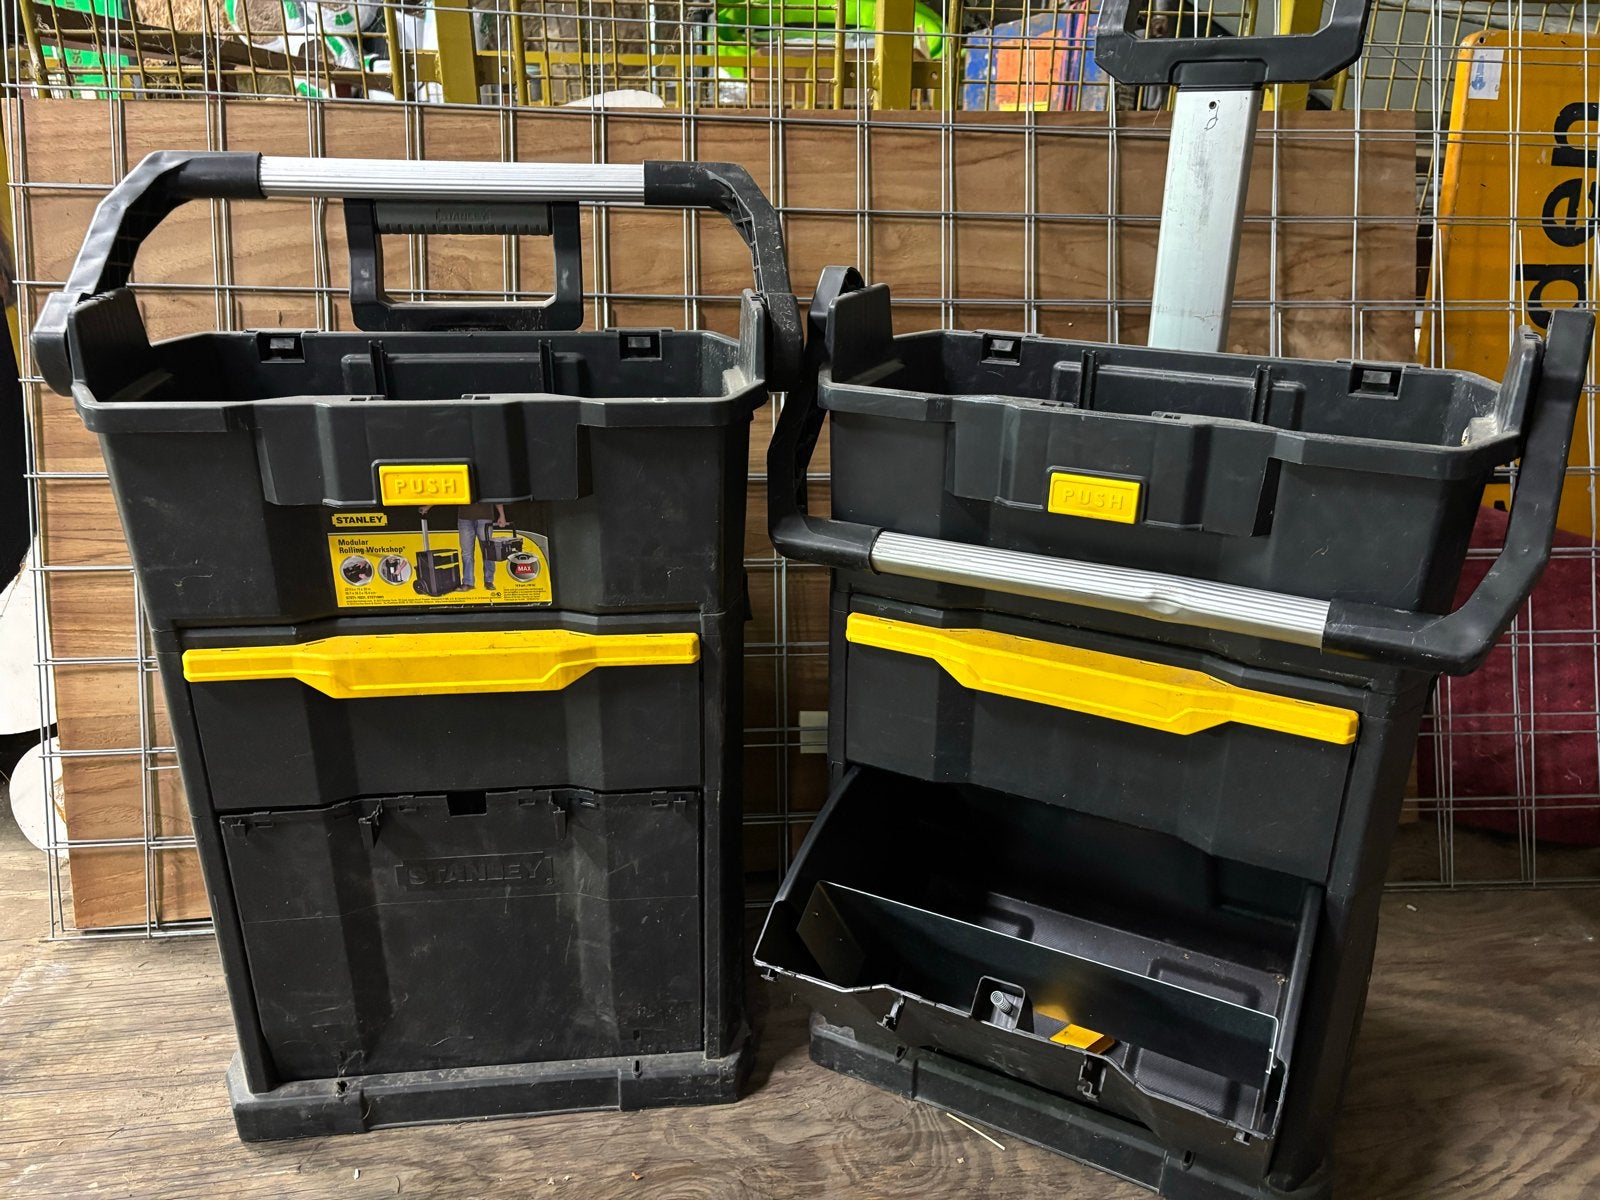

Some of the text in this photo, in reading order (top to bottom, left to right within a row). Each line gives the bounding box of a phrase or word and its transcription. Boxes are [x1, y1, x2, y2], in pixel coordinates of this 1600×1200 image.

[1514, 101, 1600, 330] den
[395, 478, 457, 494] PUSH
[1063, 488, 1124, 510] PUSH
[335, 515, 383, 524] STANLEY
[338, 538, 369, 546] Modular
[339, 546, 365, 555] Rolling
[408, 856, 544, 885] STANLEY
